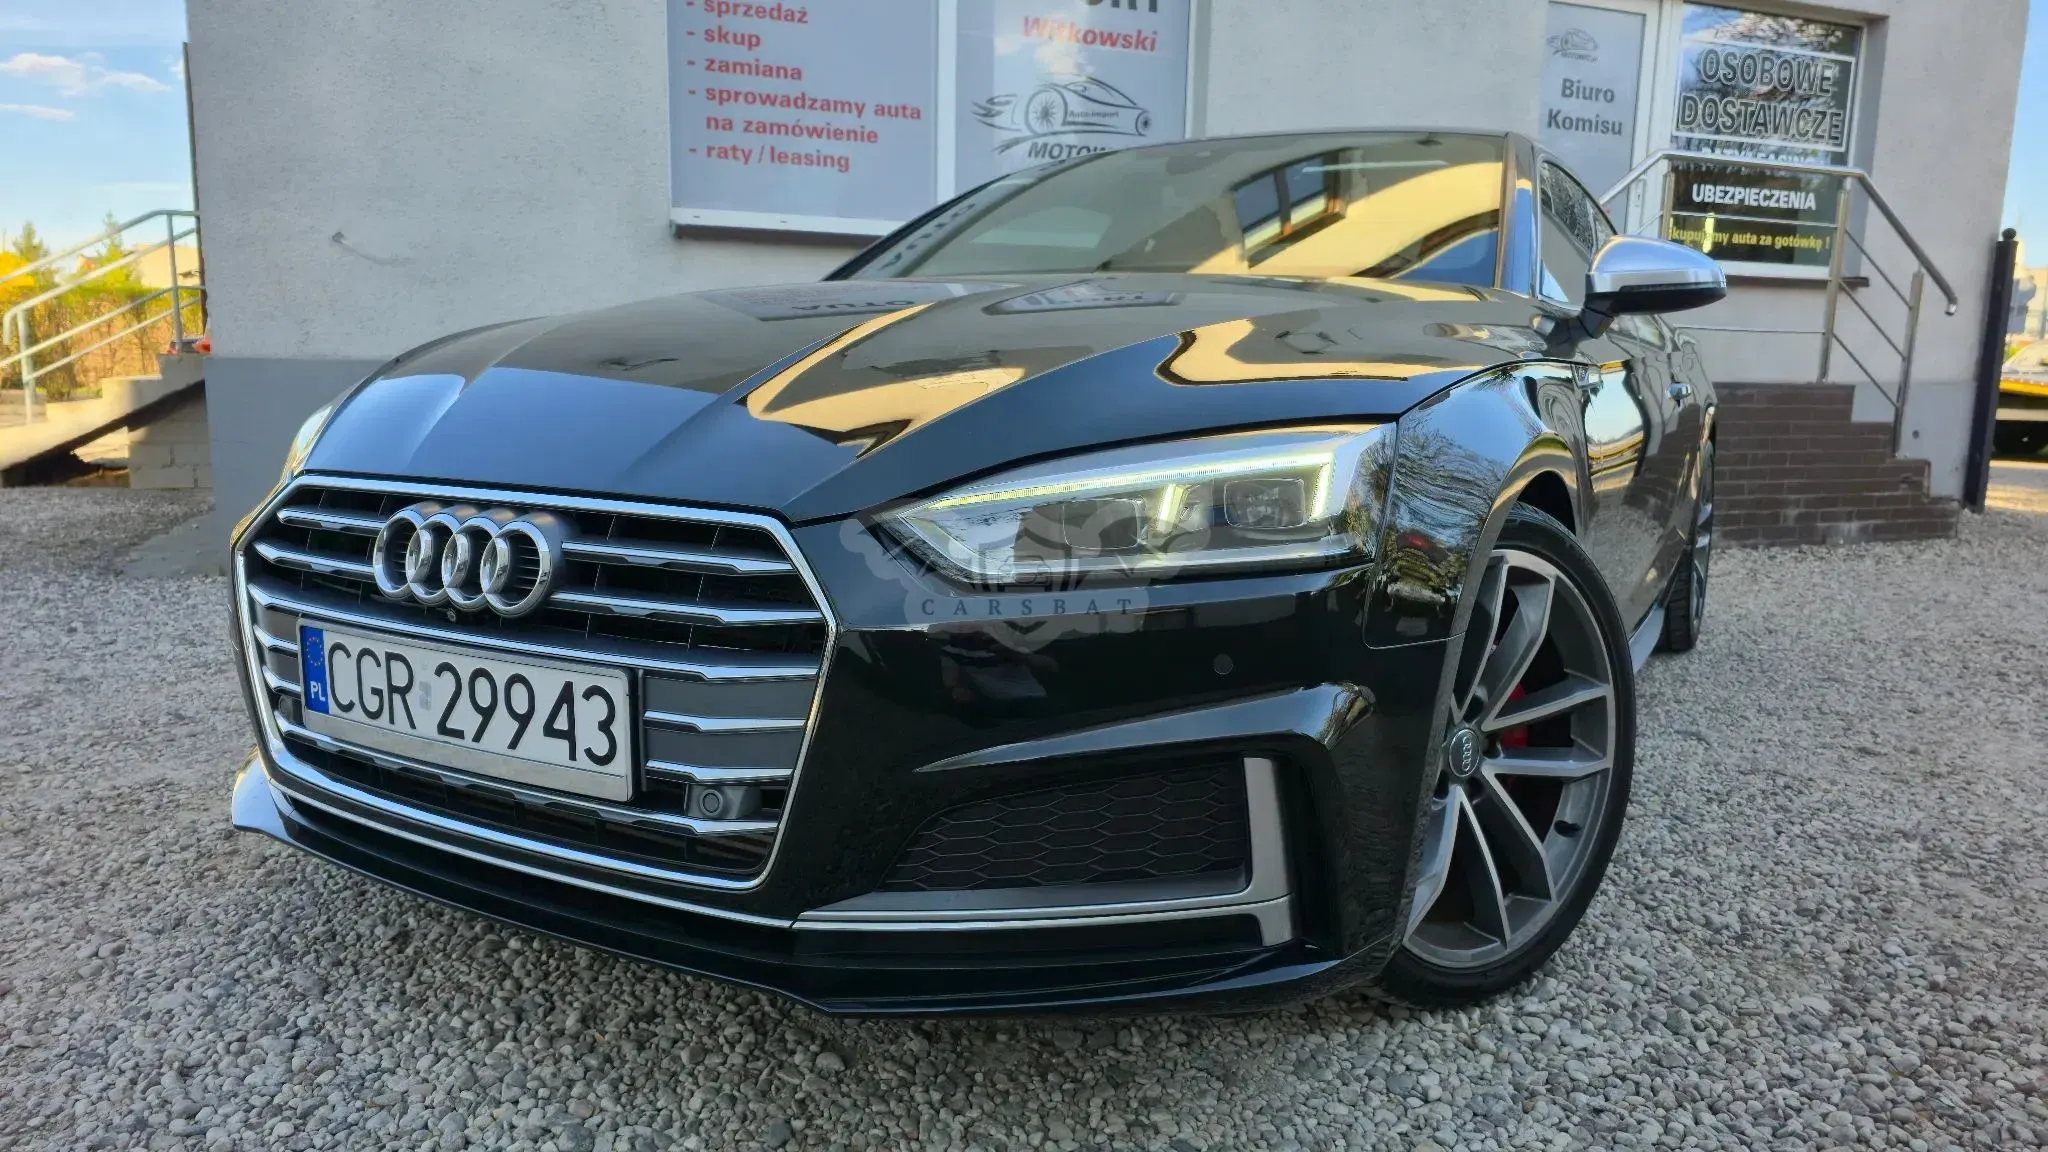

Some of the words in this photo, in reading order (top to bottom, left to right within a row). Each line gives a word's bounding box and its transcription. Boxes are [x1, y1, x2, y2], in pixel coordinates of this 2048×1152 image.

[704, 0, 808, 23] sprzedaż
[704, 26, 761, 50] skup
[705, 57, 802, 80] zamiana
[1701, 49, 1834, 96] OSOBOWE
[705, 87, 866, 118] sprowadzamy
[874, 102, 921, 120] auta
[1561, 78, 1615, 103] Biuro
[705, 115, 734, 132] na
[743, 119, 878, 144] zamówienie
[1547, 108, 1623, 136] Komisu
[1679, 92, 1843, 144] DOSTAWCZE
[706, 144, 752, 165] raty
[770, 145, 850, 173] leasing
[1692, 184, 1817, 211] UBEZPIECZENIA
[1732, 231, 1757, 245] auta
[1760, 234, 1773, 246] za
[310, 680, 326, 702] PL
[327, 641, 417, 730] CGR
[433, 661, 618, 767] 29943
